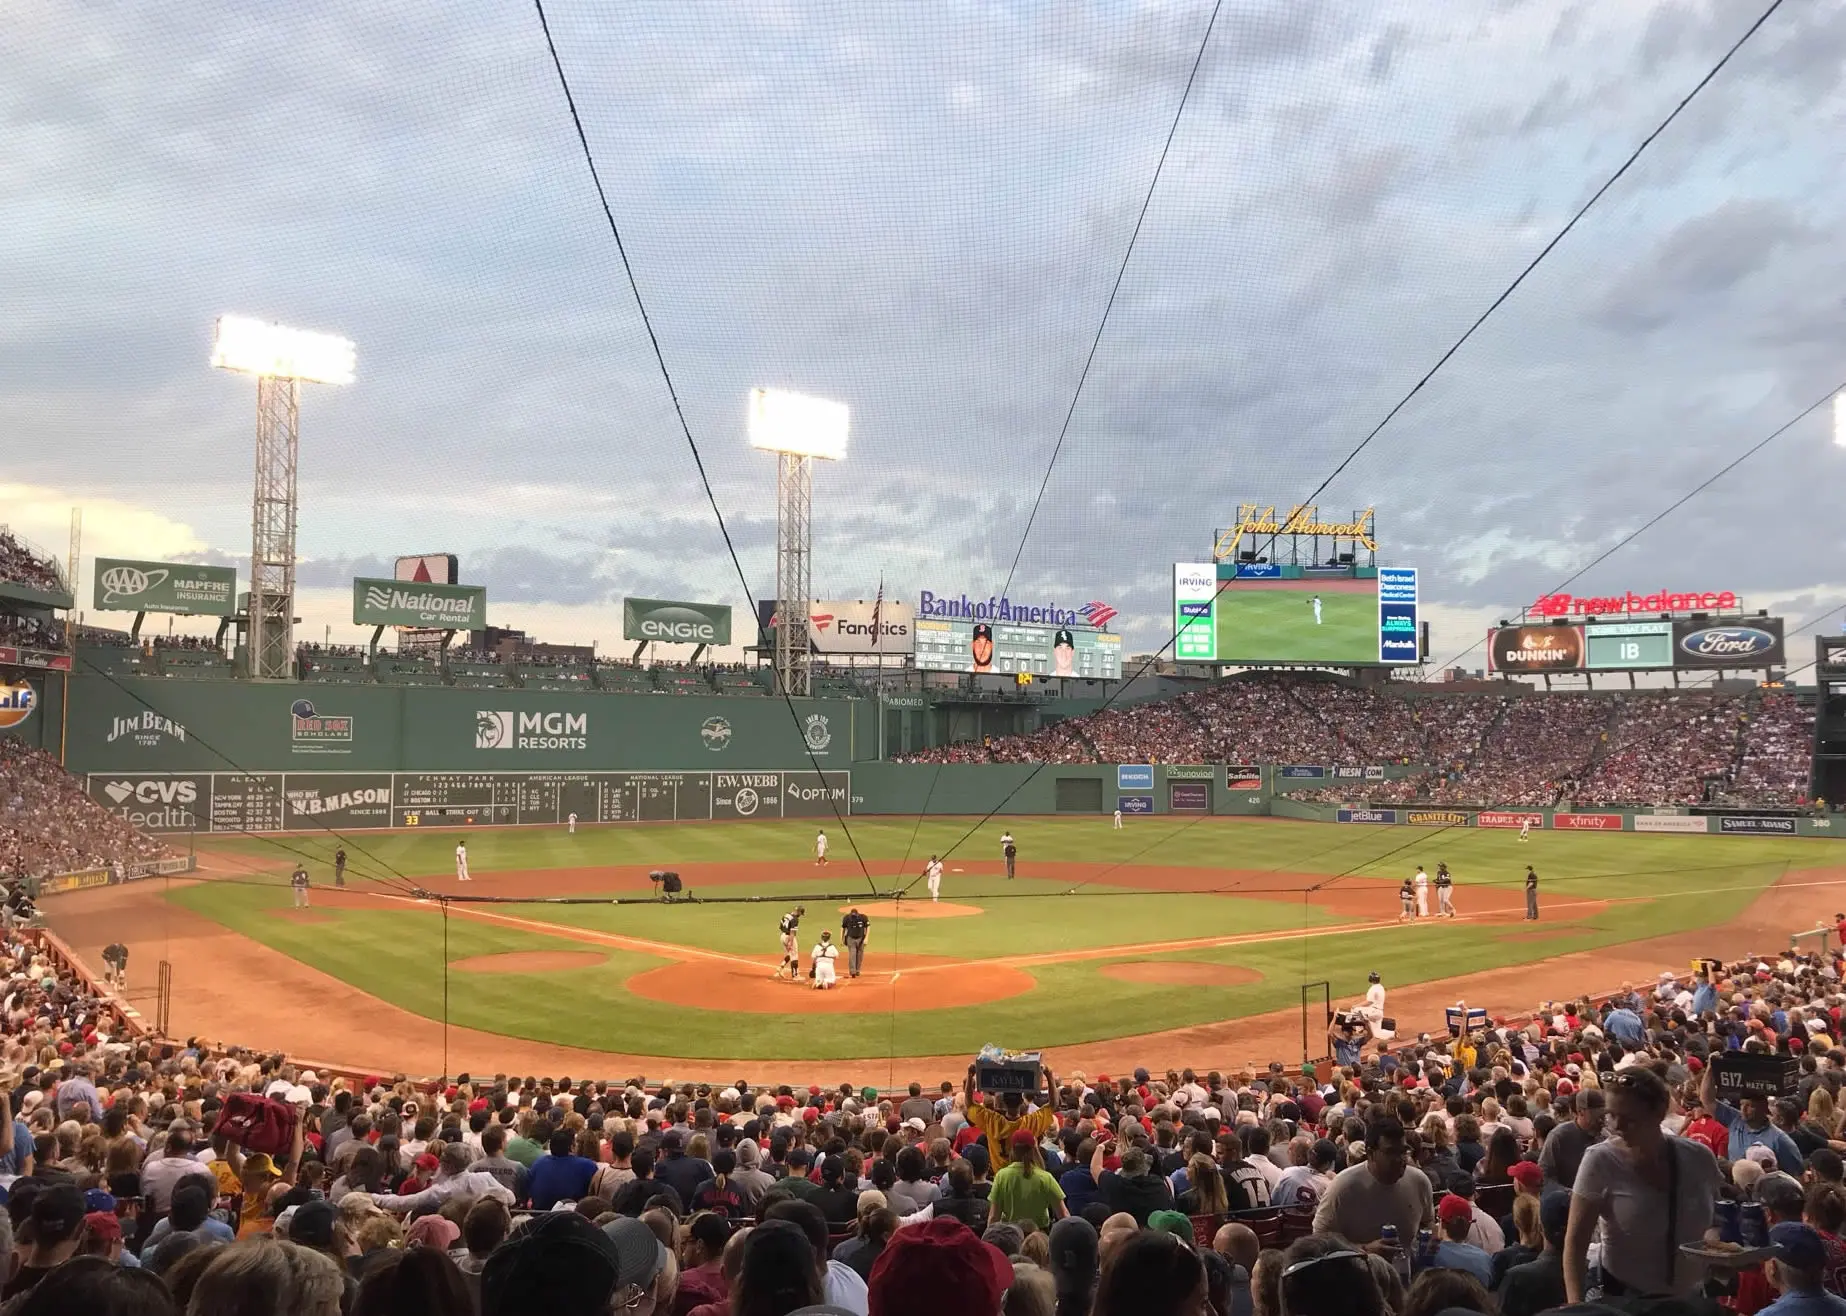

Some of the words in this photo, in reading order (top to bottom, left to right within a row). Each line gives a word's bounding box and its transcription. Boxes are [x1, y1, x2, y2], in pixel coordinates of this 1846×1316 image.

[1215, 504, 1279, 558] John
[1281, 504, 1379, 551] Hancock
[107, 568, 143, 594] AAA
[174, 580, 231, 591] MAPFRE
[1179, 578, 1212, 587] IRVING
[176, 591, 228, 602] INSURANCE
[390, 590, 474, 613] National
[920, 590, 972, 617] Bank
[976, 596, 996, 619] of
[999, 597, 1076, 626] America
[420, 612, 436, 621] Car
[439, 613, 470, 623] Rental
[1700, 631, 1755, 653] Ford
[1506, 649, 1567, 661] DUNKIN'
[1004, 660, 1010, 671] 0
[1021, 661, 1027, 672] 0
[888, 698, 924, 706] ABIOMED
[107, 716, 139, 742] JIM
[142, 710, 185, 742] BEAM
[297, 719, 322, 731] RED
[325, 719, 349, 731] SOX
[519, 712, 587, 734] MGM
[518, 737, 587, 750] RESORTS
[1338, 767, 1362, 777] NESN
[742, 775, 778, 788] WEBB
[136, 781, 197, 804] CVS
[287, 791, 304, 799] WHO
[305, 791, 319, 799] BUT
[801, 788, 845, 801] OPTUM
[716, 797, 732, 806] Since
[107, 806, 197, 828] Health
[405, 815, 418, 825] 33
[1350, 809, 1383, 822] jetBlue
[1408, 813, 1446, 824] GRANITE
[1481, 815, 1514, 824] TRADER
[1569, 815, 1607, 828] xfinity
[1723, 819, 1757, 829] SAMUEL
[1759, 819, 1792, 830] ADAMS
[1812, 819, 1830, 827] 380
[1720, 1071, 1742, 1088] 617
[1746, 1081, 1764, 1090] HAZY
[1766, 1083, 1777, 1091] IPA
